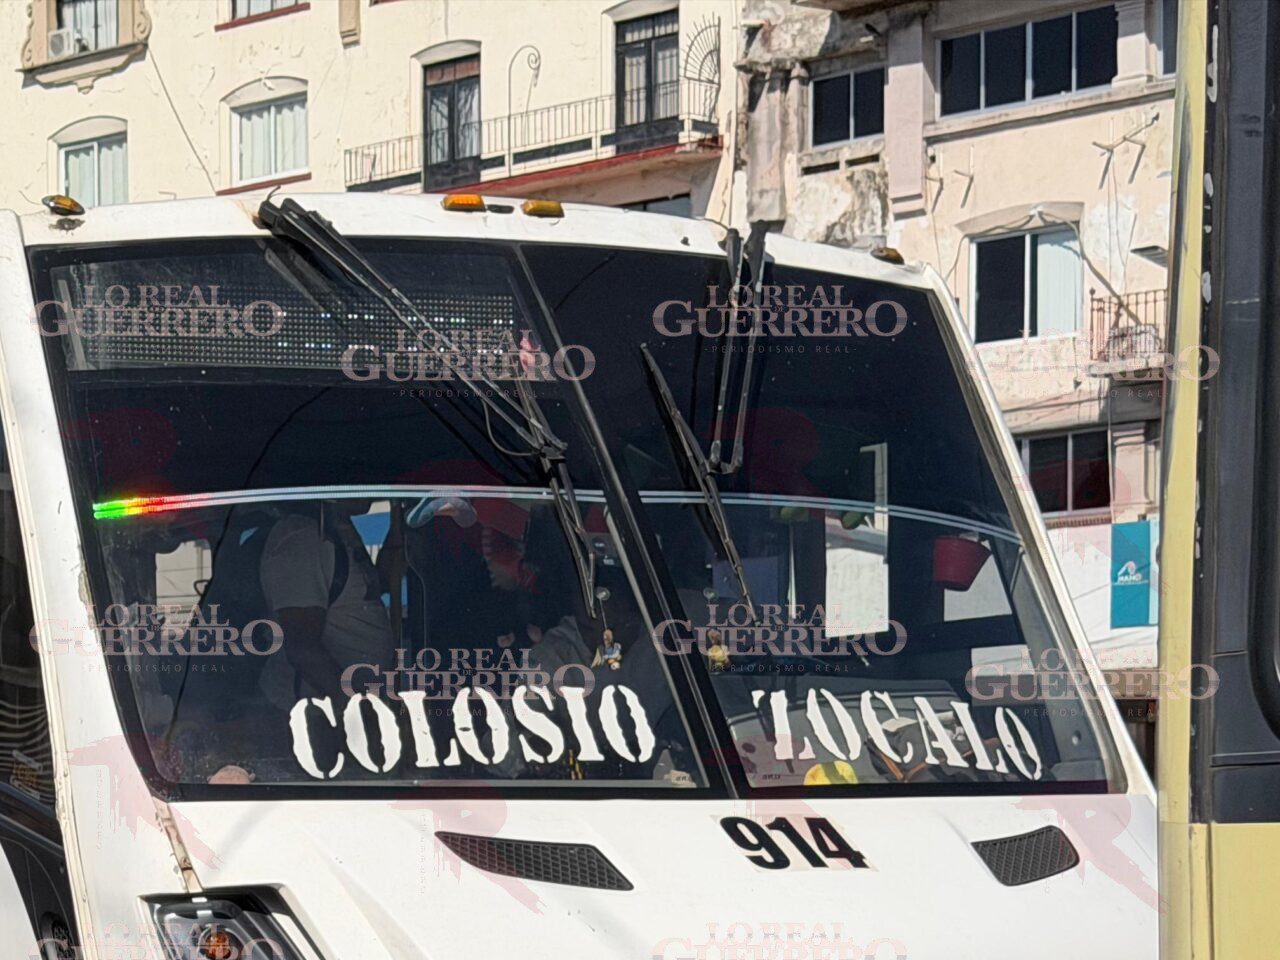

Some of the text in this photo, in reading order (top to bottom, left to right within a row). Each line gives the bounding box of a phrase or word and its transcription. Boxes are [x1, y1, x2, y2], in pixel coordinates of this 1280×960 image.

[289, 685, 656, 779] COLOSIO
[751, 688, 1043, 780] ZOCALO
[720, 815, 870, 870] 914
